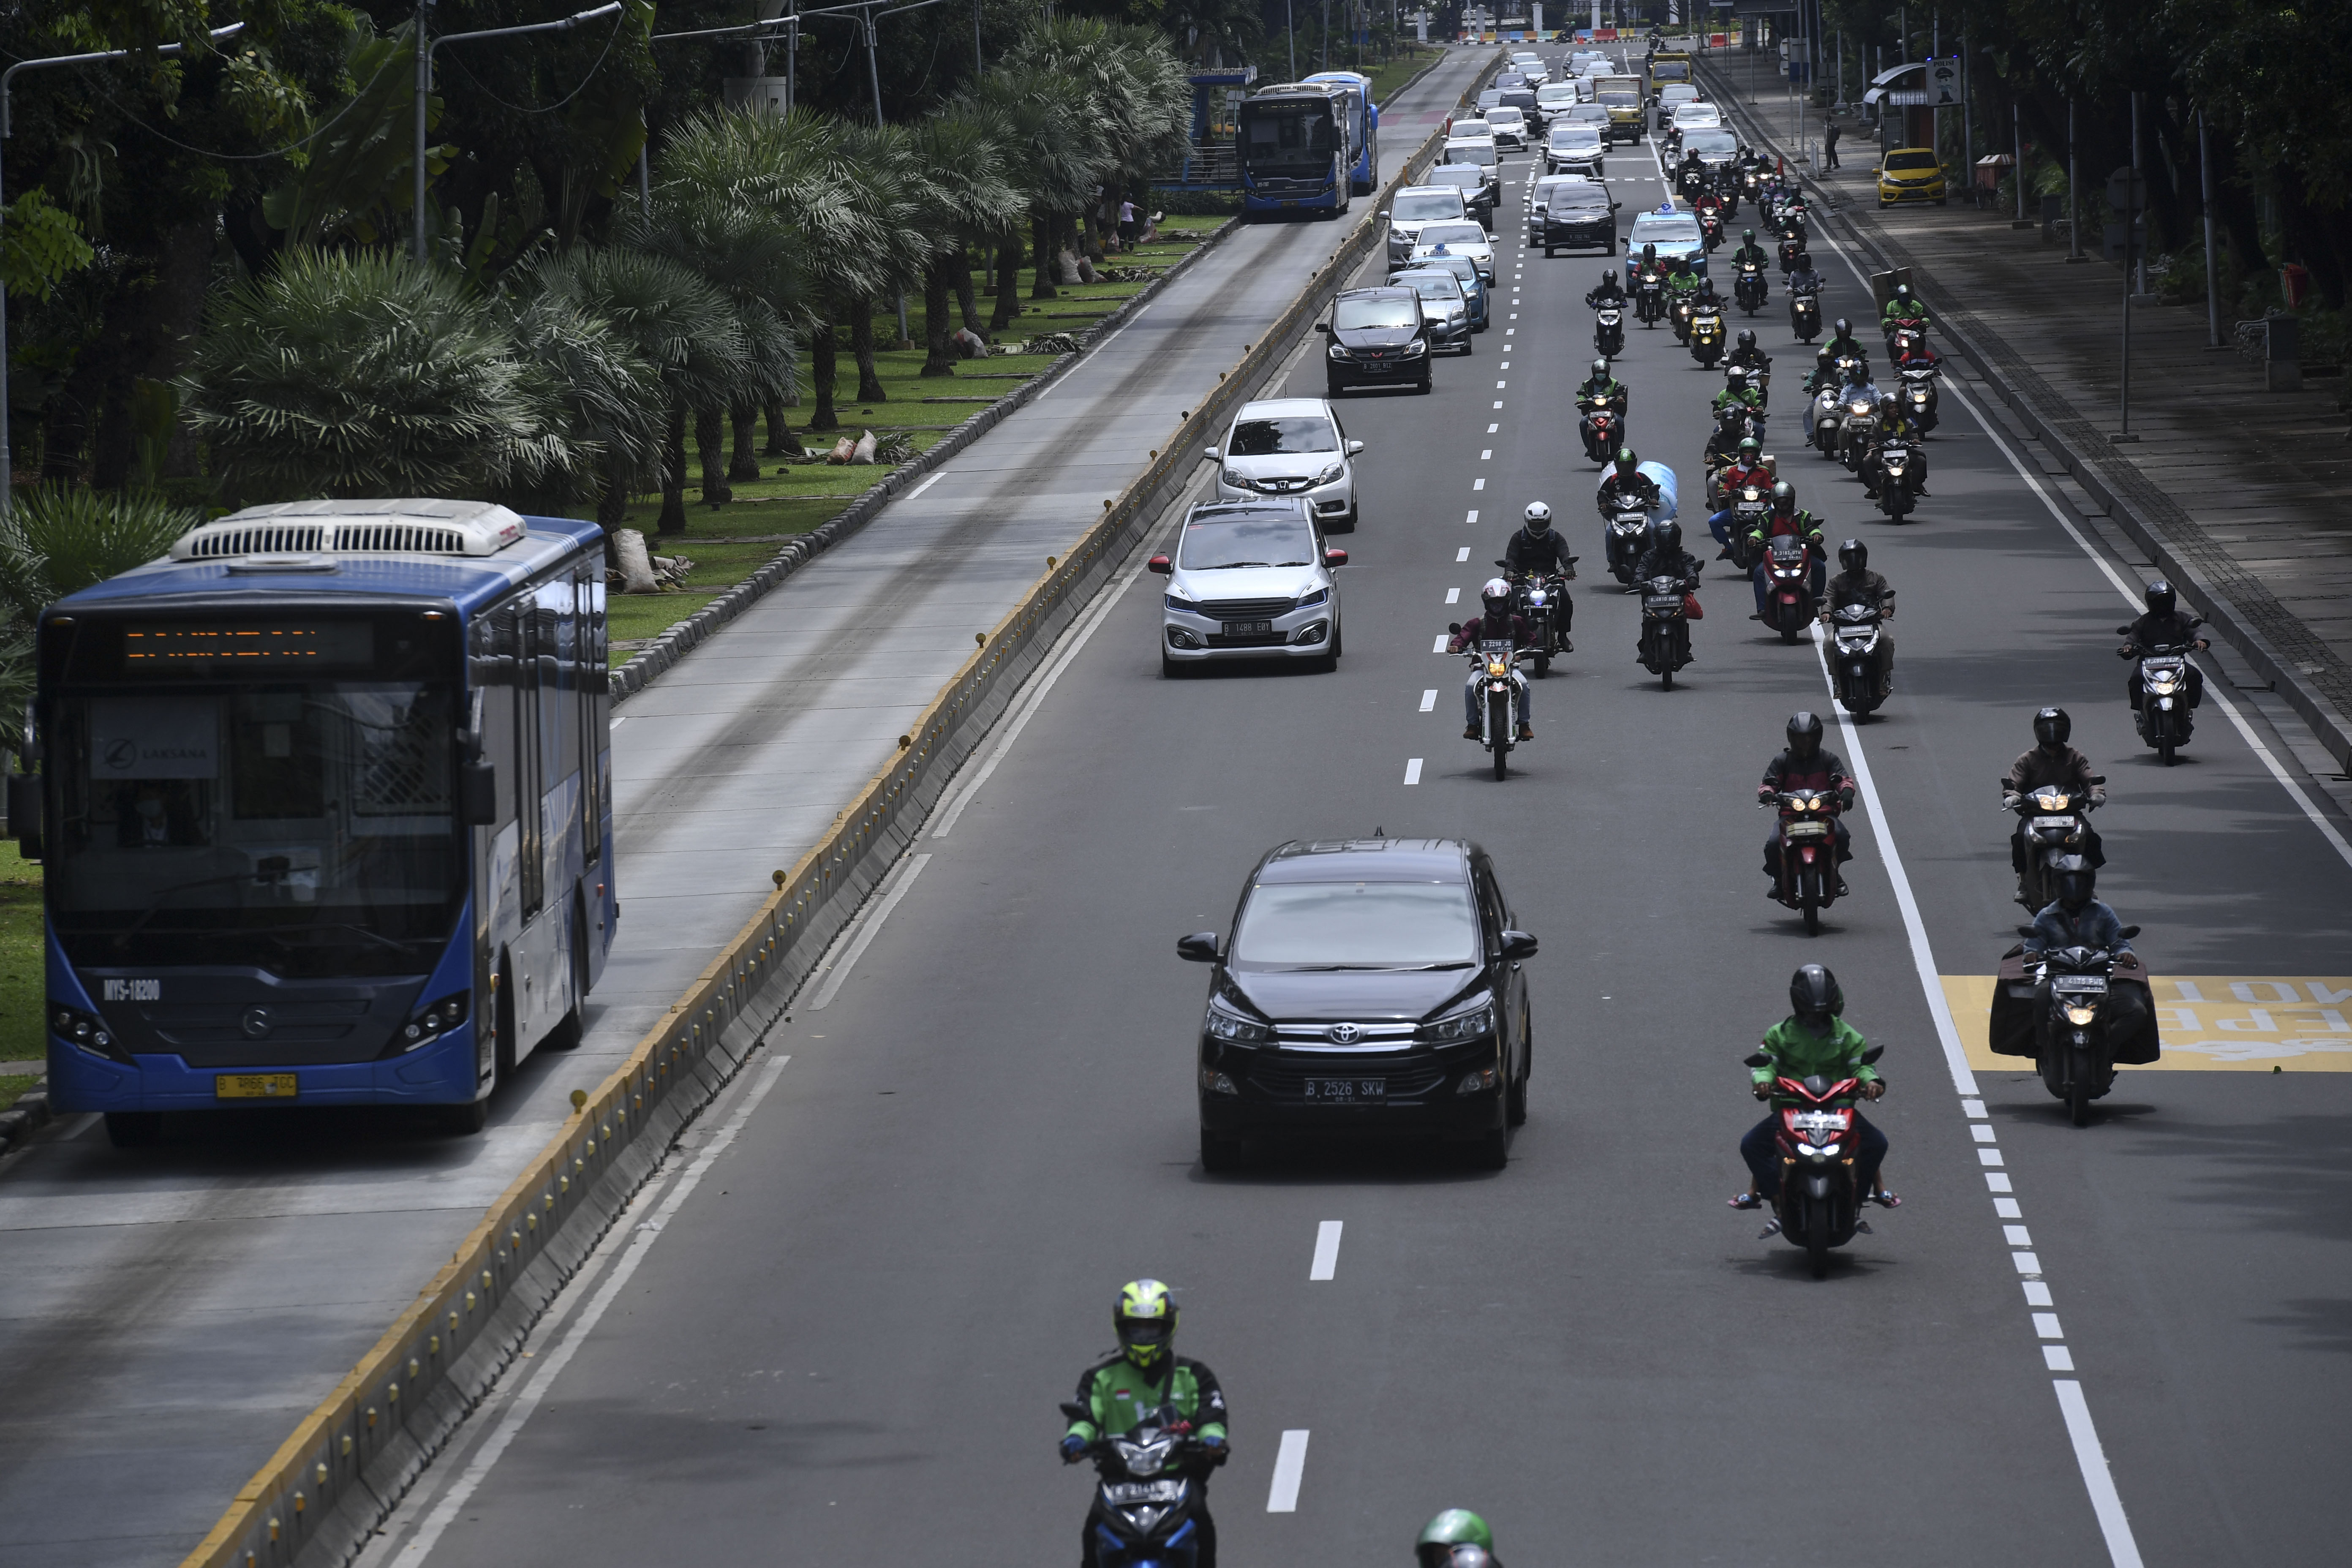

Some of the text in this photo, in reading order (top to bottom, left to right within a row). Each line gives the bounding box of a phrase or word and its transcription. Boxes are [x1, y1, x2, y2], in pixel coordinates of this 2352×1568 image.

[1225, 624, 1229, 632] B
[1236, 623, 1252, 632] 1488
[143, 749, 207, 759] LAKSANA
[2167, 981, 2352, 1004] MOT
[219, 1078, 226, 1090] B
[1308, 1081, 1384, 1096] B 2526 SKW
